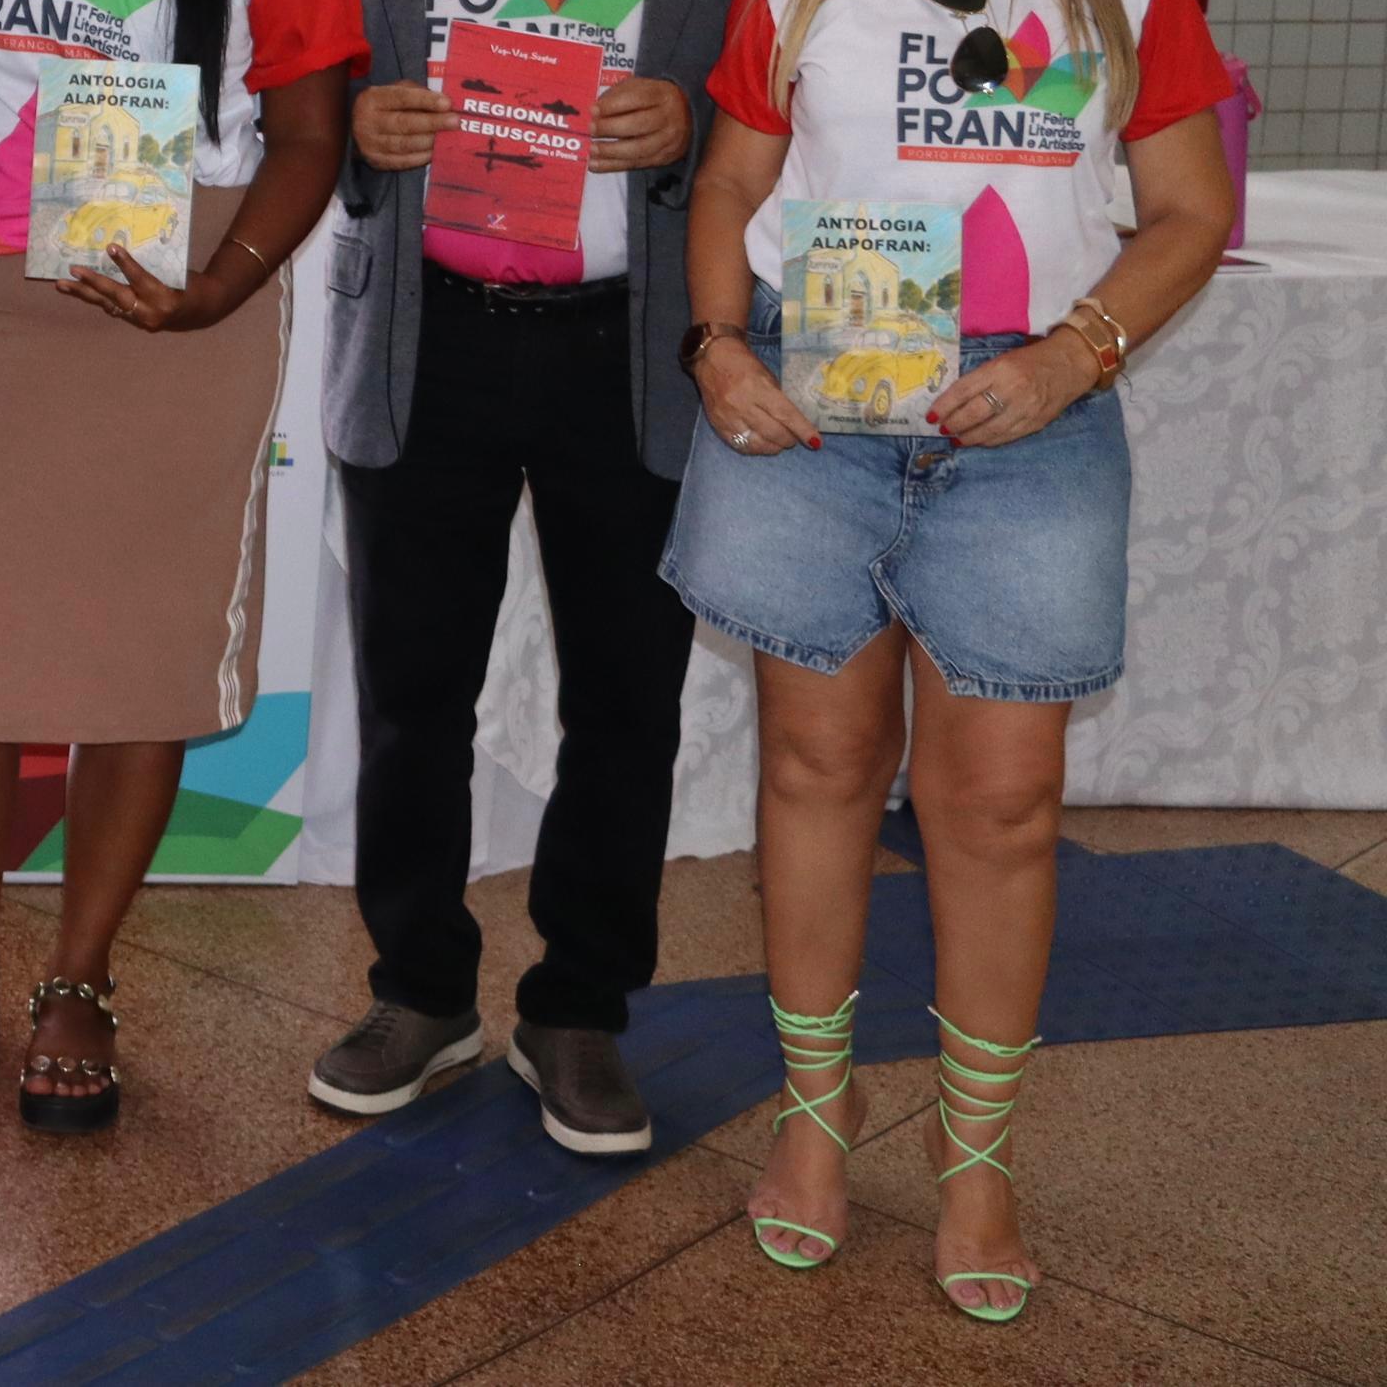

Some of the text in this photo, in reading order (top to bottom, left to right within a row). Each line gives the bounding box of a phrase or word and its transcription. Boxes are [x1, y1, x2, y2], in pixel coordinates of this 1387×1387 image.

[90, 6, 124, 28] Feira
[74, 17, 131, 46] Literária
[579, 22, 615, 38] Feira
[3, 38, 56, 52] FRANCO
[72, 34, 140, 62] e Artística
[899, 32, 949, 65] FL
[68, 73, 167, 91] ANTOLOGIA
[897, 67, 966, 104] PO
[63, 92, 170, 110] ALAPOFRAN:
[463, 98, 569, 129] REGIONAL
[1043, 111, 1075, 127] Feira
[460, 118, 581, 150] REBUSCADO
[897, 108, 1026, 147] FRAN
[1028, 124, 1082, 139] Literária
[1027, 138, 1085, 151] e Artística
[907, 149, 1004, 162] PORTO FRANCO
[816, 216, 927, 233] ANTOLOGIA
[811, 236, 931, 253] ALAPOFRAN:
